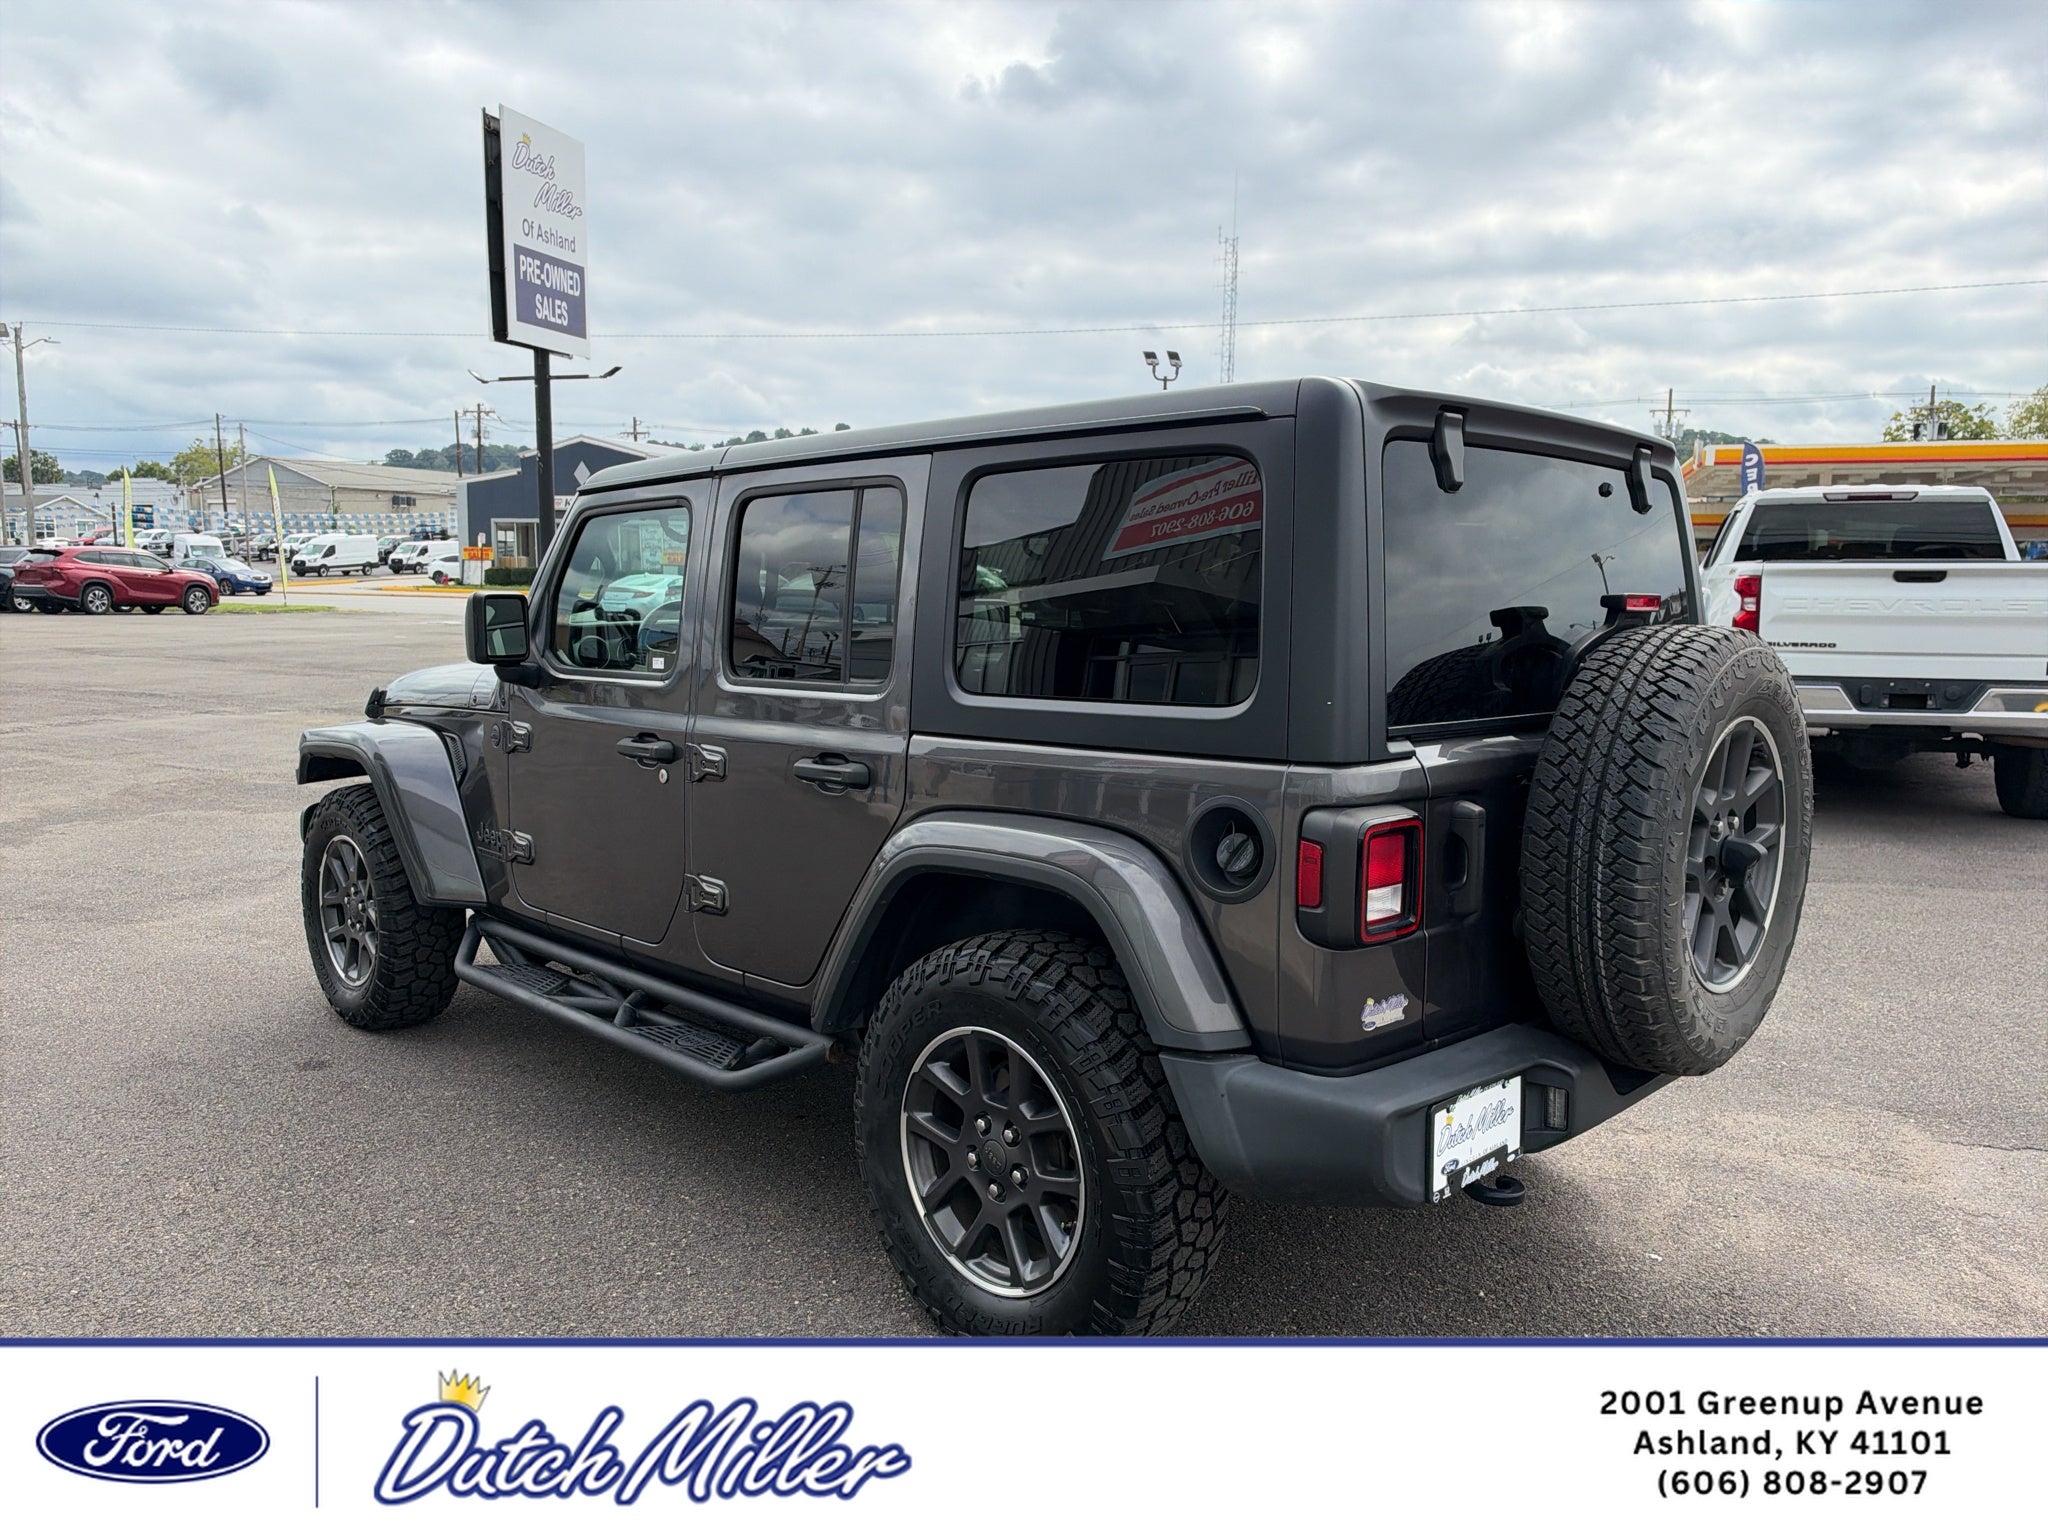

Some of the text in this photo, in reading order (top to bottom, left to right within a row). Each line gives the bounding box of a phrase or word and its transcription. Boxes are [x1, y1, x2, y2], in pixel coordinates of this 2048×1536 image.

[511, 140, 555, 181] Dutch
[533, 181, 583, 220] Miller
[522, 218, 576, 253] Of Ashland
[519, 254, 581, 297] PRE-OWNED
[535, 293, 569, 327] SALES
[1437, 1098, 1515, 1157] Dutch Miller
